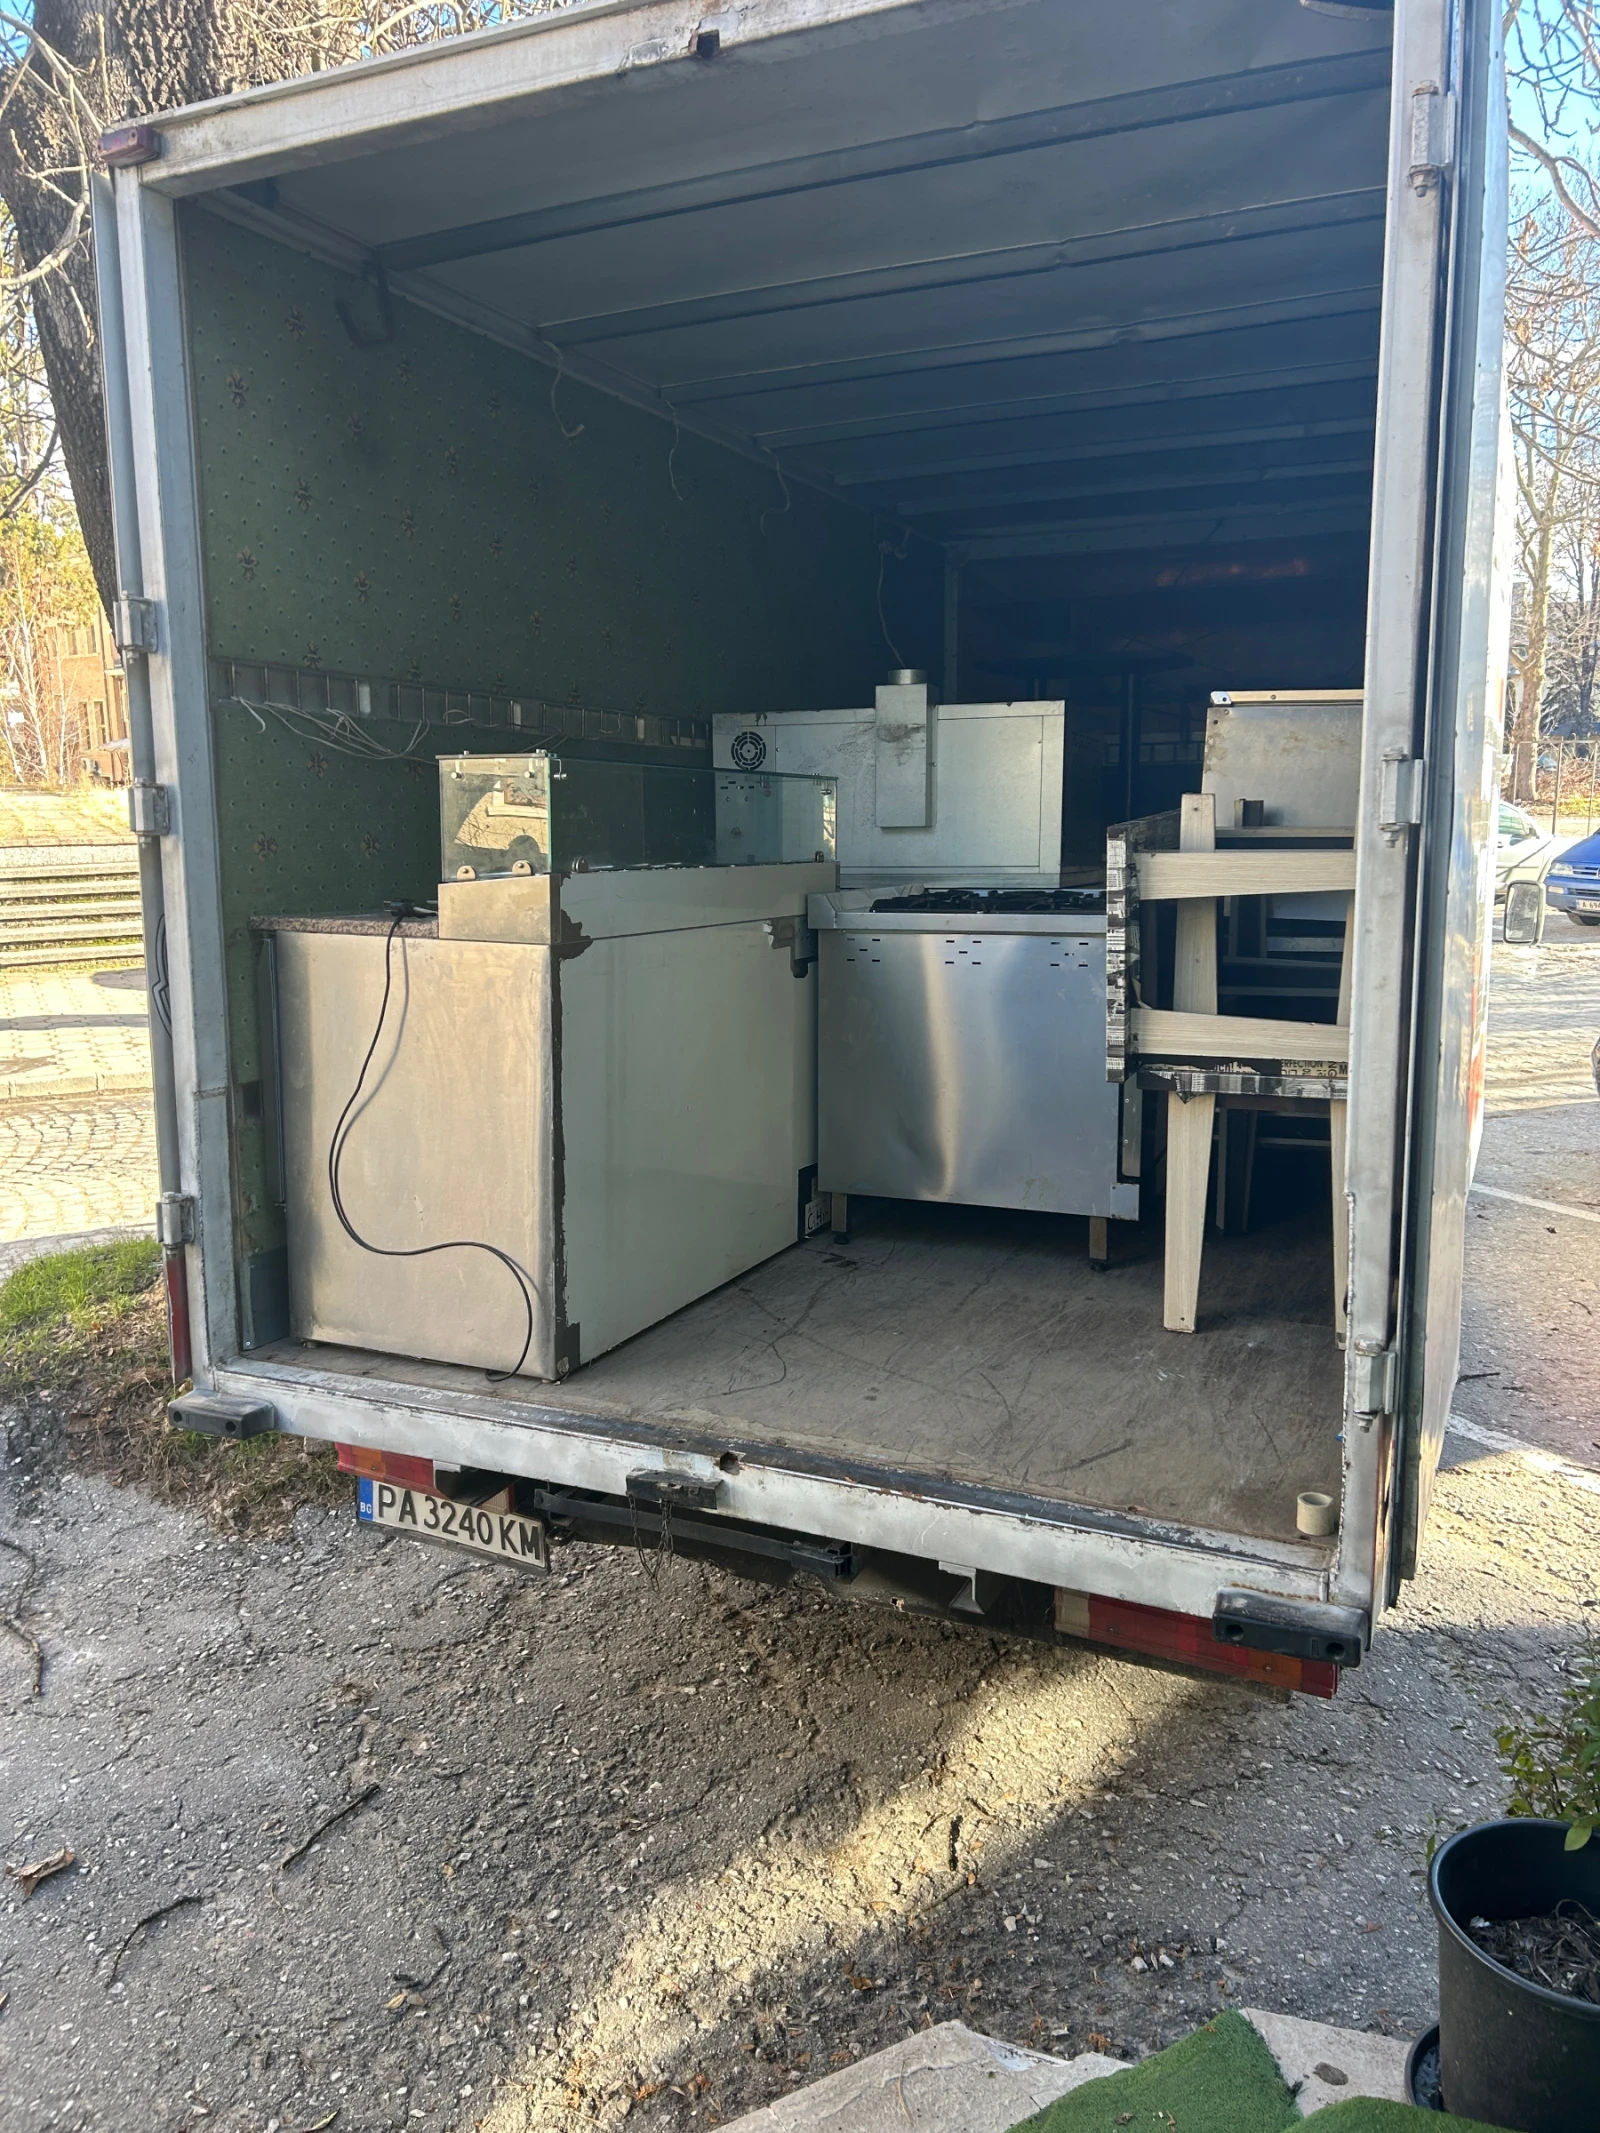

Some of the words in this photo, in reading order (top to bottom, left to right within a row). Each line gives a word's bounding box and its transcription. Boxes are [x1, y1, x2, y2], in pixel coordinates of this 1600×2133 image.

[360, 1501, 372, 1514] BG
[378, 1484, 418, 1525] PA
[423, 1497, 493, 1545] 3240
[499, 1516, 541, 1561] KM
